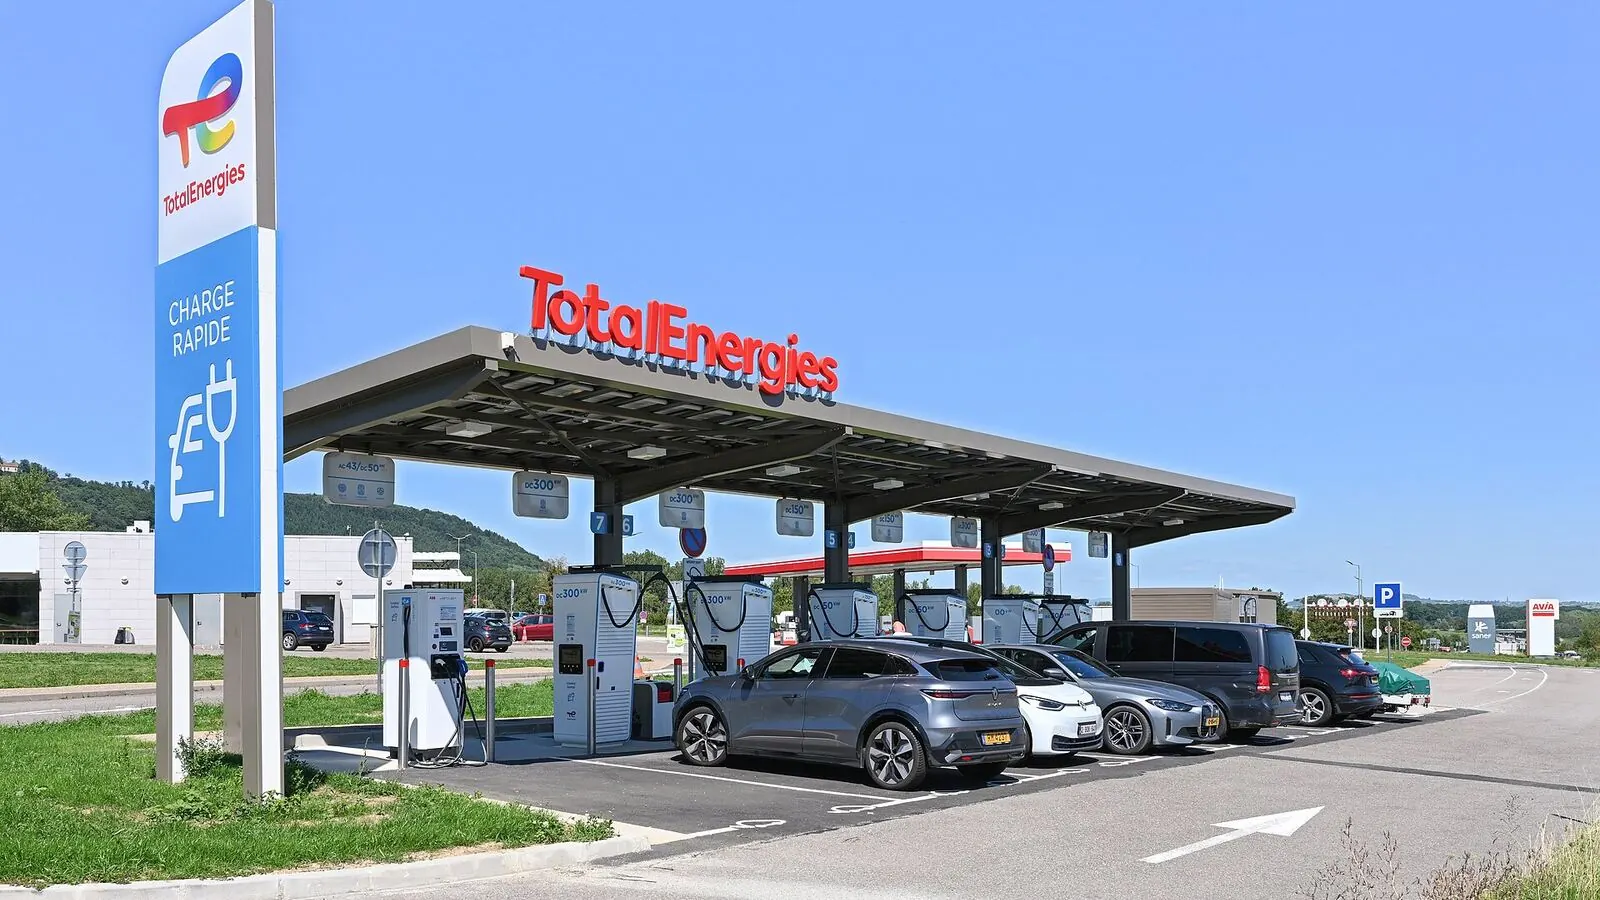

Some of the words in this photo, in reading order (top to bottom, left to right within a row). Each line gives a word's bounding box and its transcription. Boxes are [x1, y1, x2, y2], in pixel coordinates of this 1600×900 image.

[163, 163, 245, 217] TotalEnergies
[169, 280, 235, 326] CHARGE
[173, 315, 231, 357] RAPIDE
[519, 264, 838, 395] TotalEnergies
[596, 515, 605, 531] 7
[622, 518, 631, 533] 6
[829, 532, 836, 546] 5
[1381, 587, 1394, 605] P
